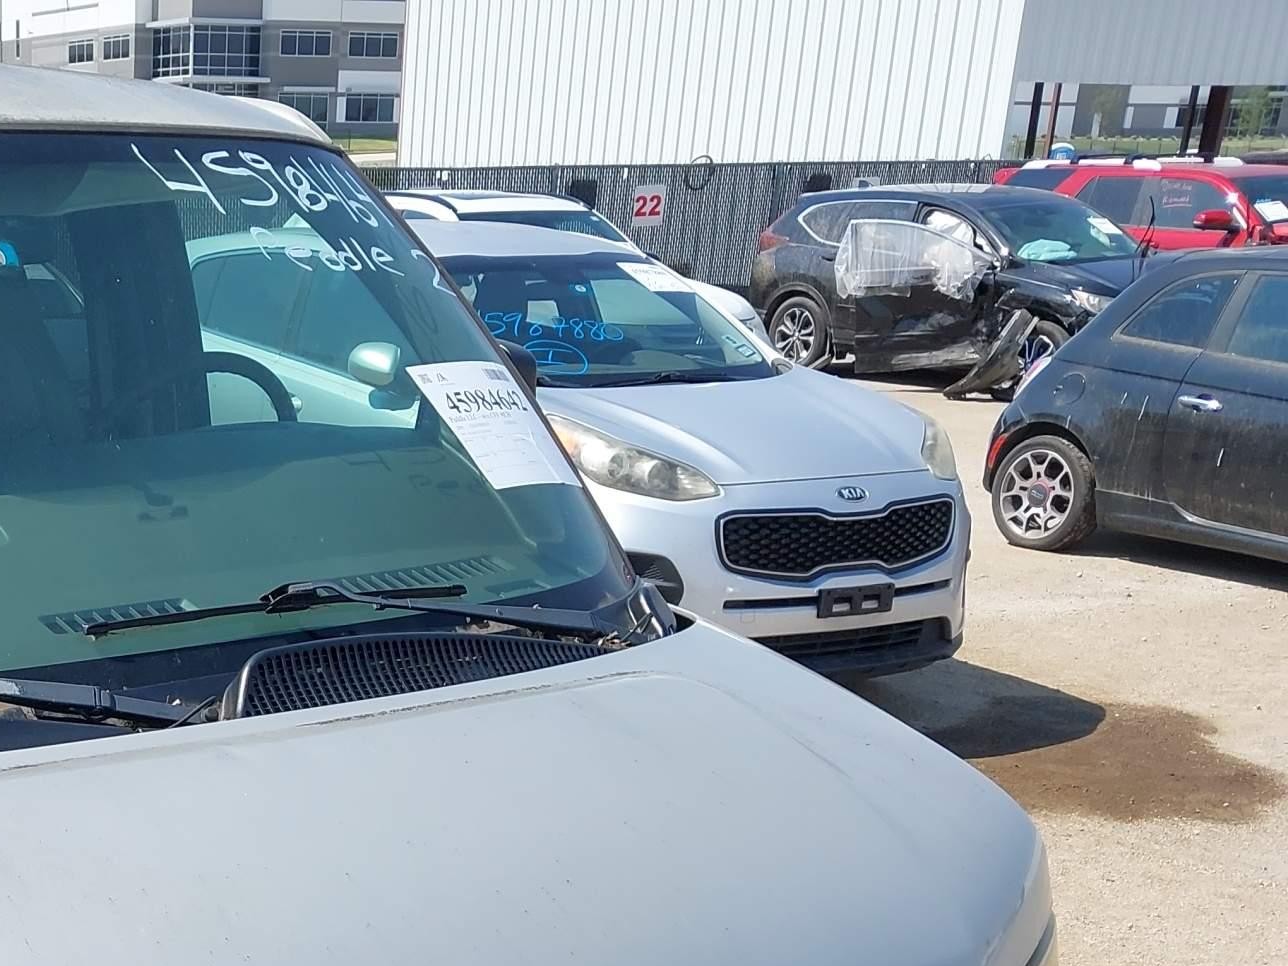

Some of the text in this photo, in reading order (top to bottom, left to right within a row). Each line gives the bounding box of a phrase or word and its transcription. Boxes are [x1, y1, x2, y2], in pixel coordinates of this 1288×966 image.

[634, 194, 662, 217] 22
[445, 388, 528, 413] 45984642
[840, 487, 865, 500] KIA
